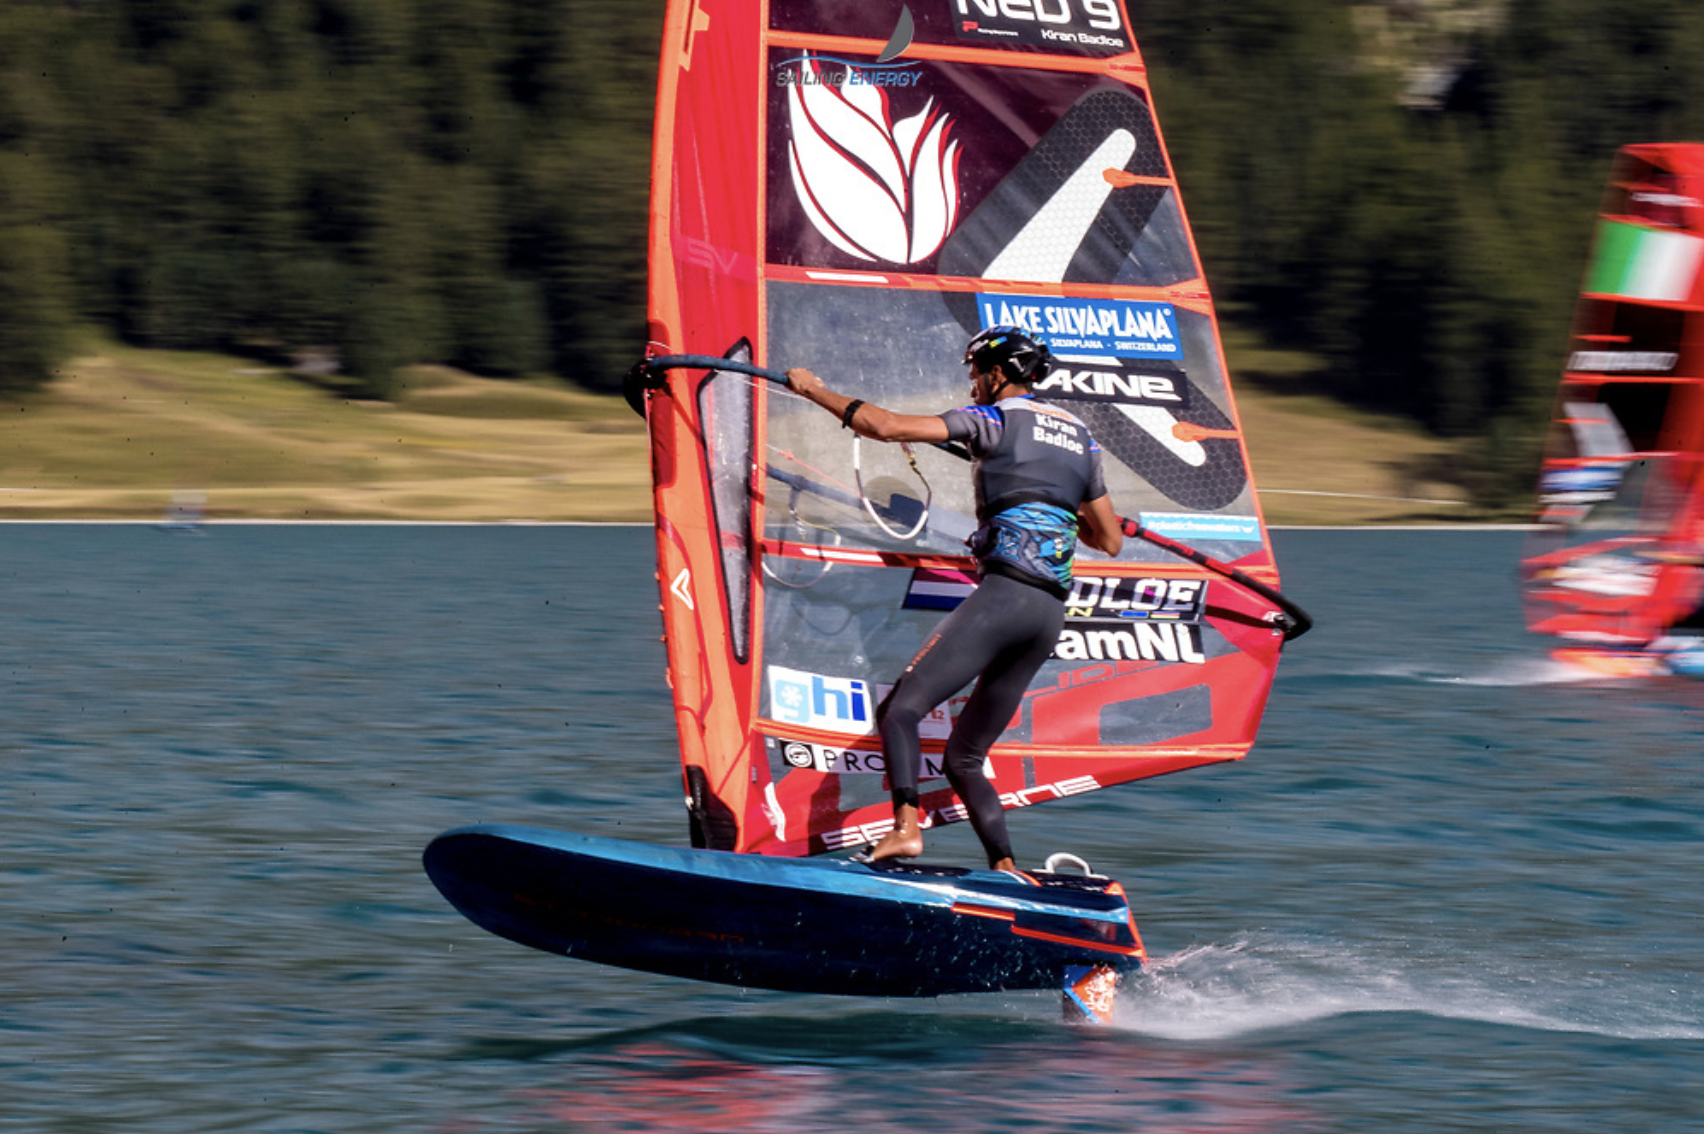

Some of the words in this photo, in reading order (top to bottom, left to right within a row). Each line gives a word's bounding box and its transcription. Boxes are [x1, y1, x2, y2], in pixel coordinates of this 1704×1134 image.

[1083, 0, 1120, 30] 9
[1041, 29, 1077, 42] Kiran
[1078, 32, 1124, 47] Badloe
[984, 302, 1044, 333] LAKE
[1114, 341, 1177, 352] SWITZERLAND
[1034, 369, 1182, 400] AKINE
[1035, 413, 1078, 437] Kiran
[1033, 426, 1084, 455] Badloe
[1064, 577, 1201, 610] DLOE
[1053, 622, 1206, 664] amNL
[775, 676, 866, 723] ghi
